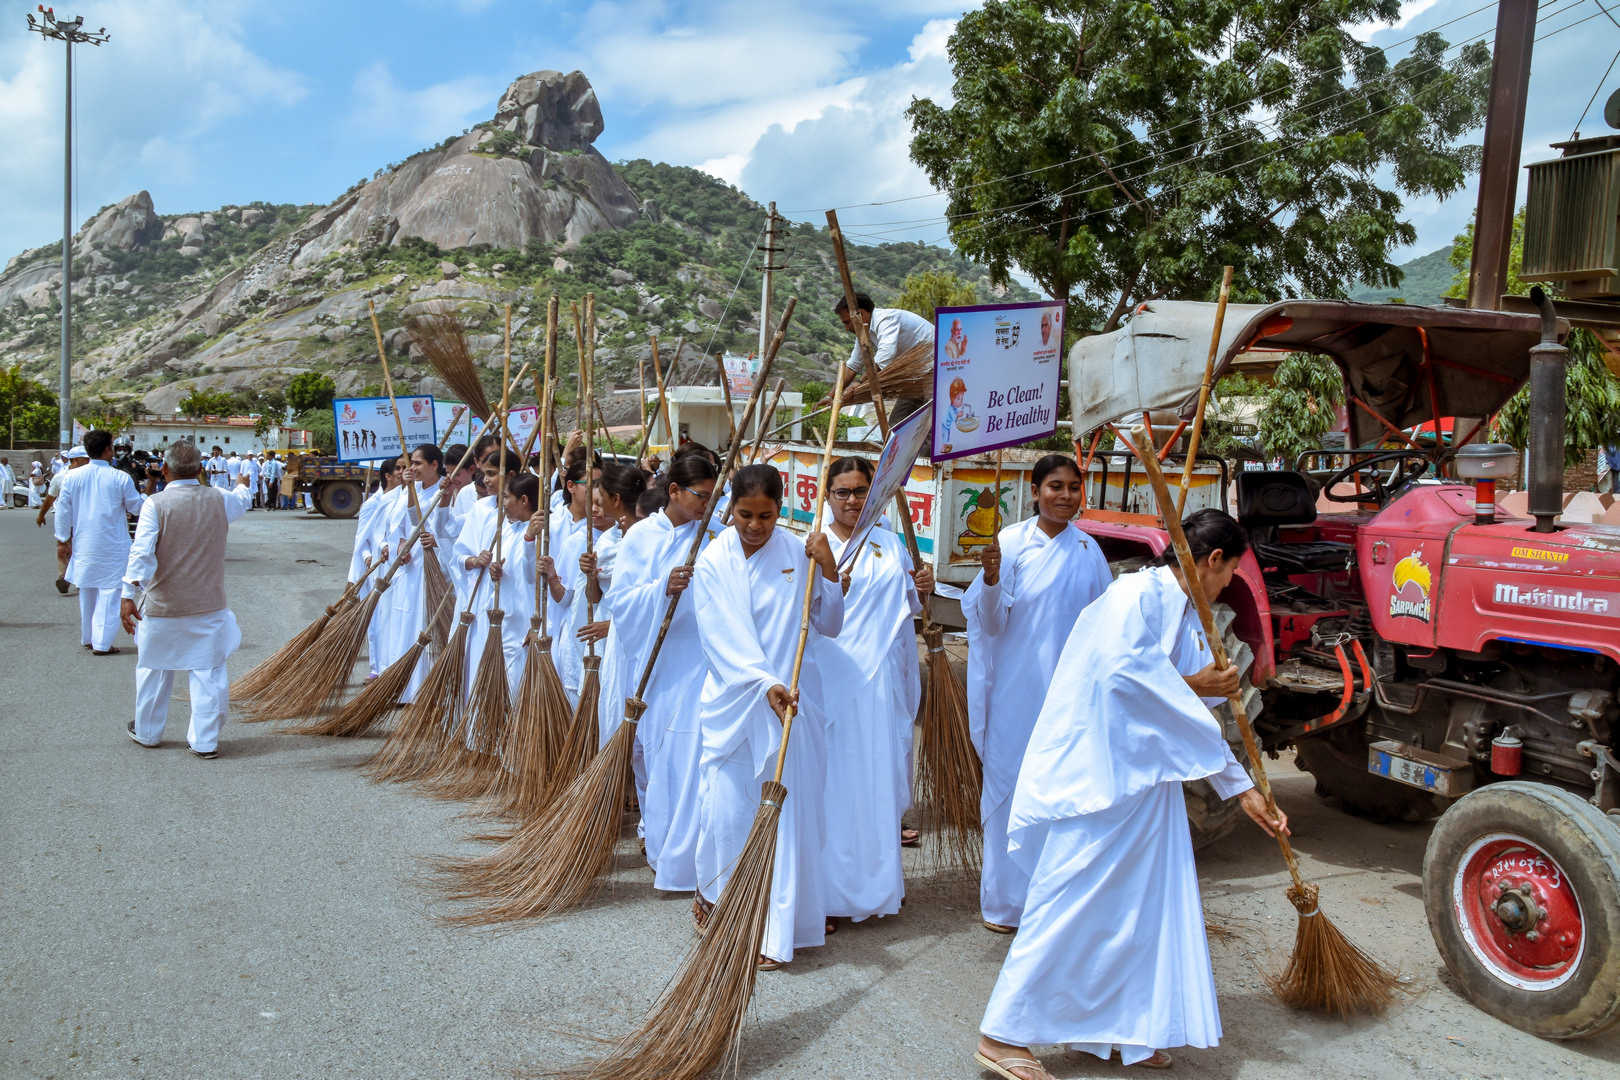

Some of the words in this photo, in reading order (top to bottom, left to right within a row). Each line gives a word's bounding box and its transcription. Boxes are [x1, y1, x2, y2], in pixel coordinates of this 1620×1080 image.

[986, 390, 1004, 409] Be
[1007, 382, 1044, 405] Clean!
[986, 415, 1003, 433] Be
[1005, 404, 1050, 429] Healthy
[1513, 547, 1529, 558] OM
[1494, 583, 1609, 614] Mahindra
